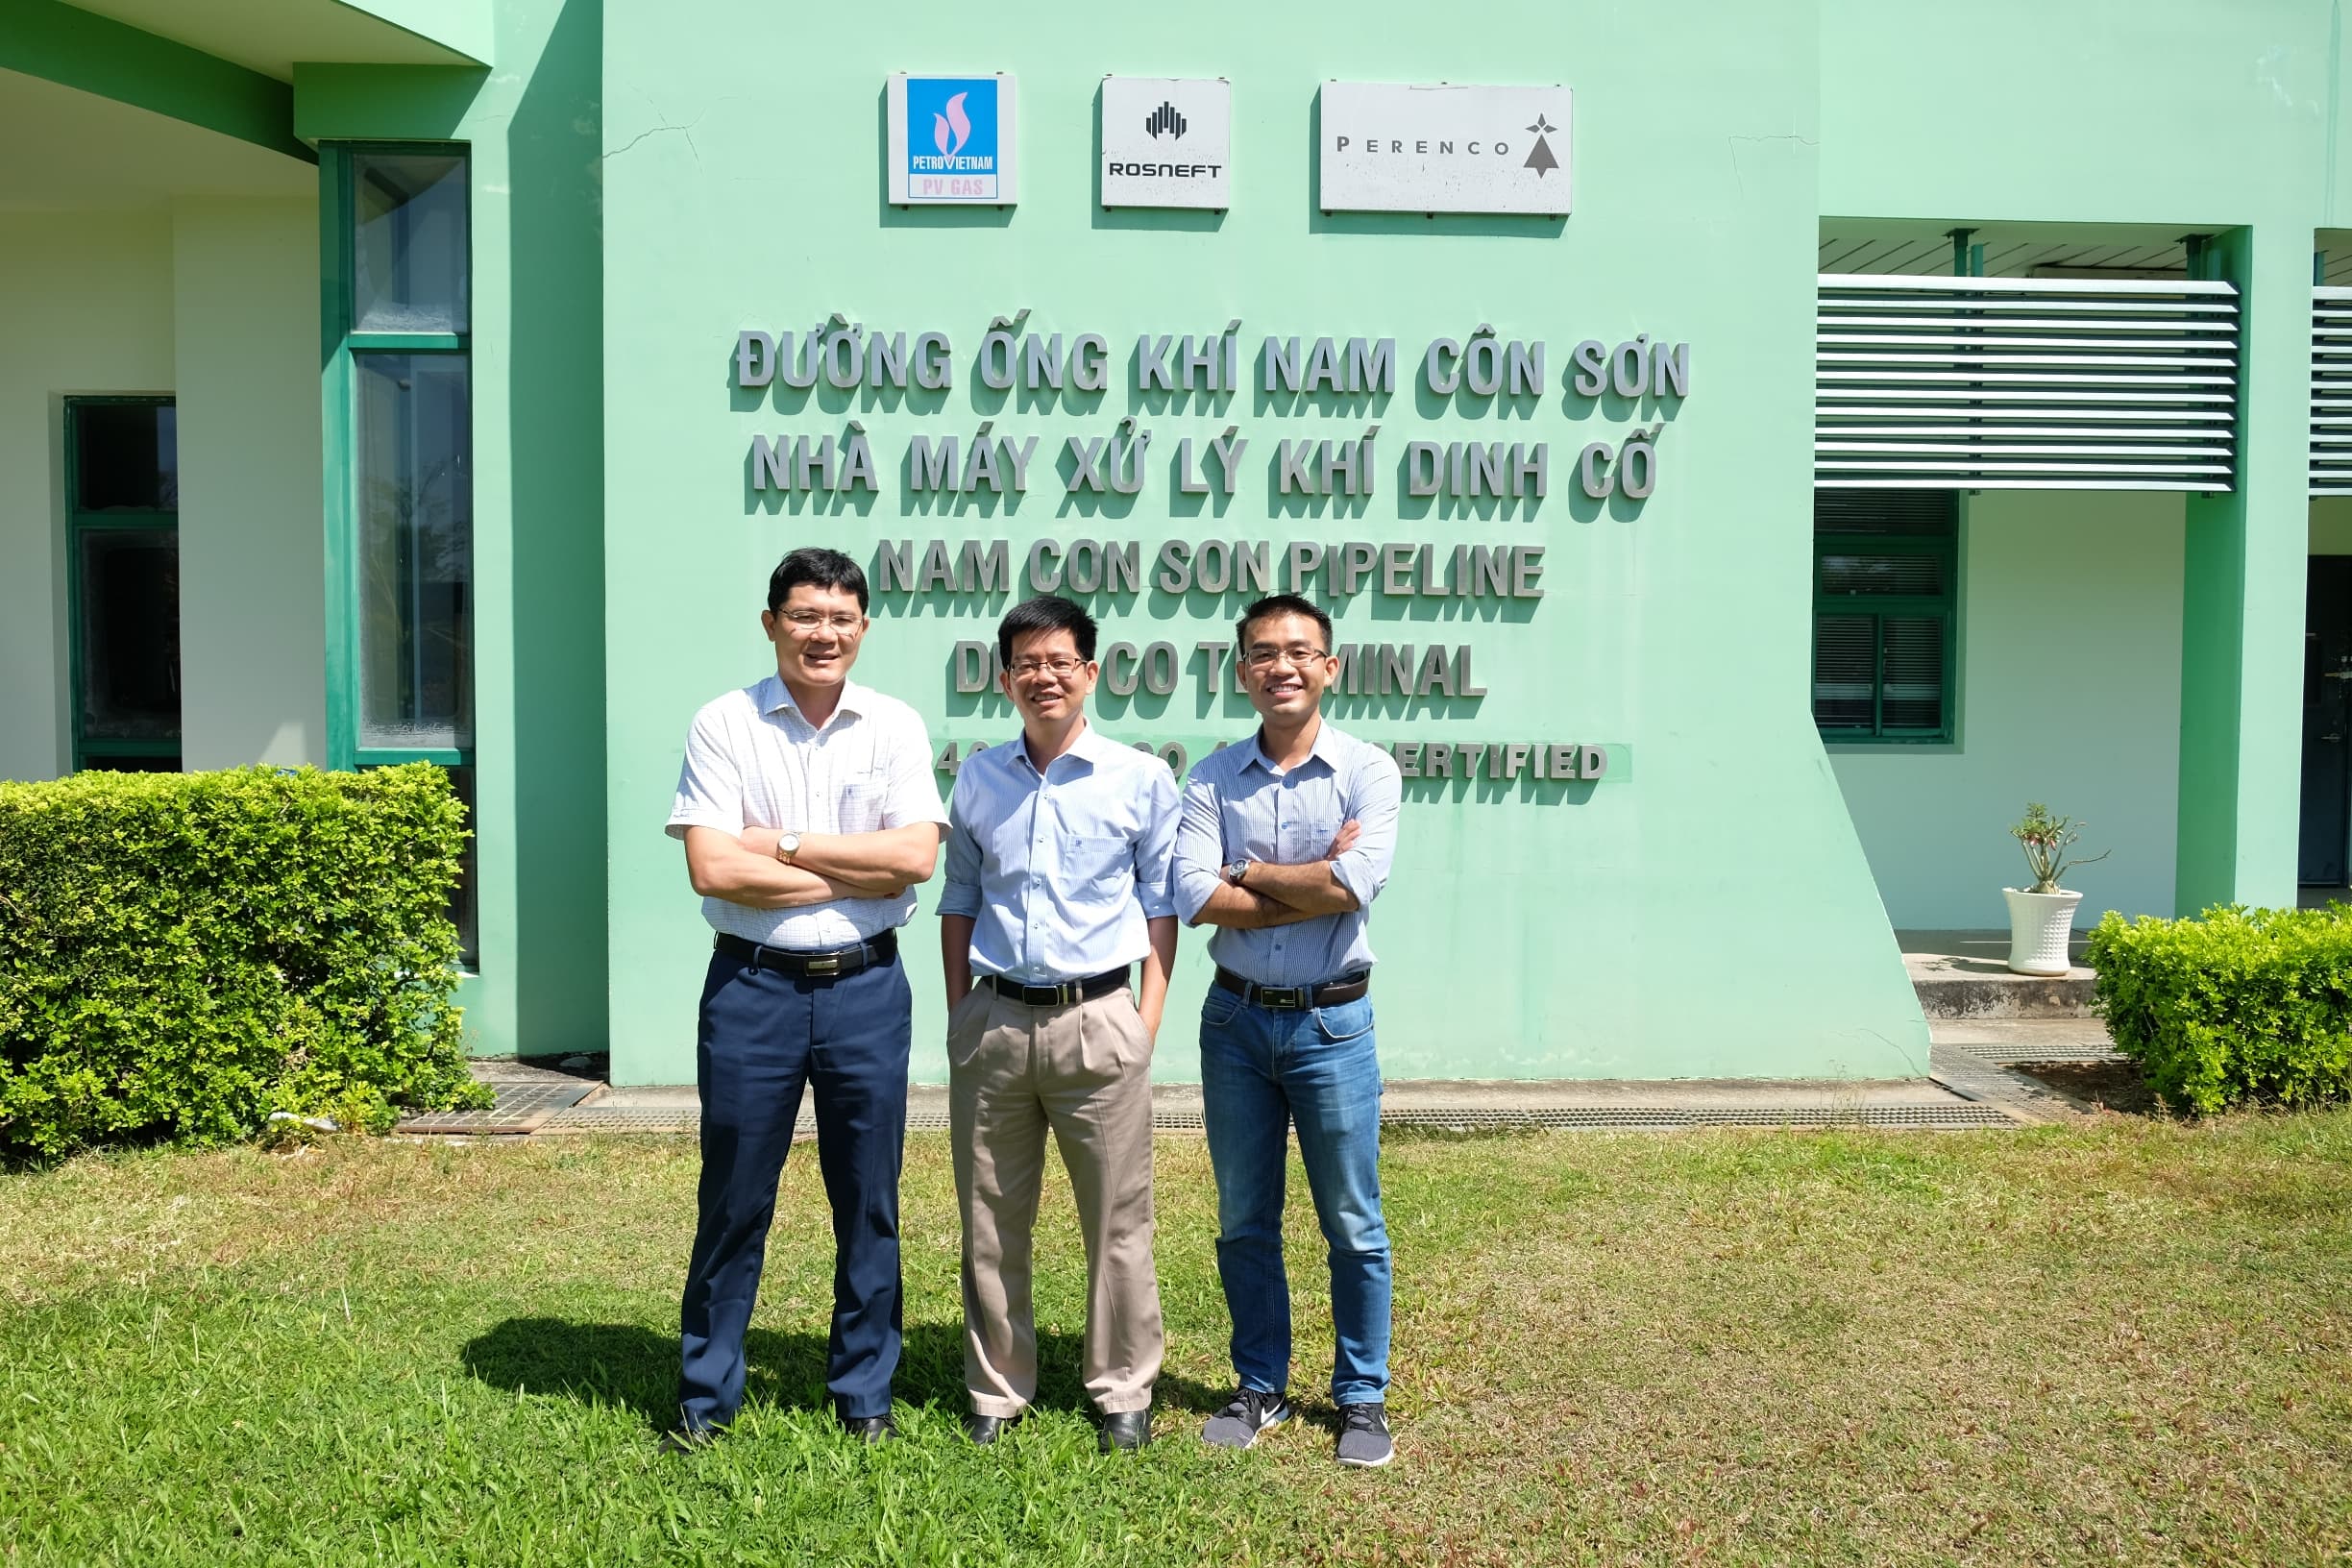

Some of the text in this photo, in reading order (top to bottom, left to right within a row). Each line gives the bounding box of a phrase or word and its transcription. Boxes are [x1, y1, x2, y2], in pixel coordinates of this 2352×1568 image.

[913, 155, 993, 170] PETROVIETNAM
[1336, 135, 1509, 156] PERENCO
[922, 178, 984, 195] PV GAS
[1109, 162, 1222, 179] ROSNEFT
[736, 309, 1690, 397] ĐƯỜNG ỐNG KHÍ NAM CÔN SƠN
[753, 416, 1666, 500] NHÀ MÁY XỬ LÝ KHÍ DINH CỐ
[878, 538, 1545, 599] NAM CON SON PIPELINE
[1106, 641, 1179, 696] CO
[1197, 641, 1488, 698] TMINAL
[1380, 741, 1608, 780] ERTIFIED
